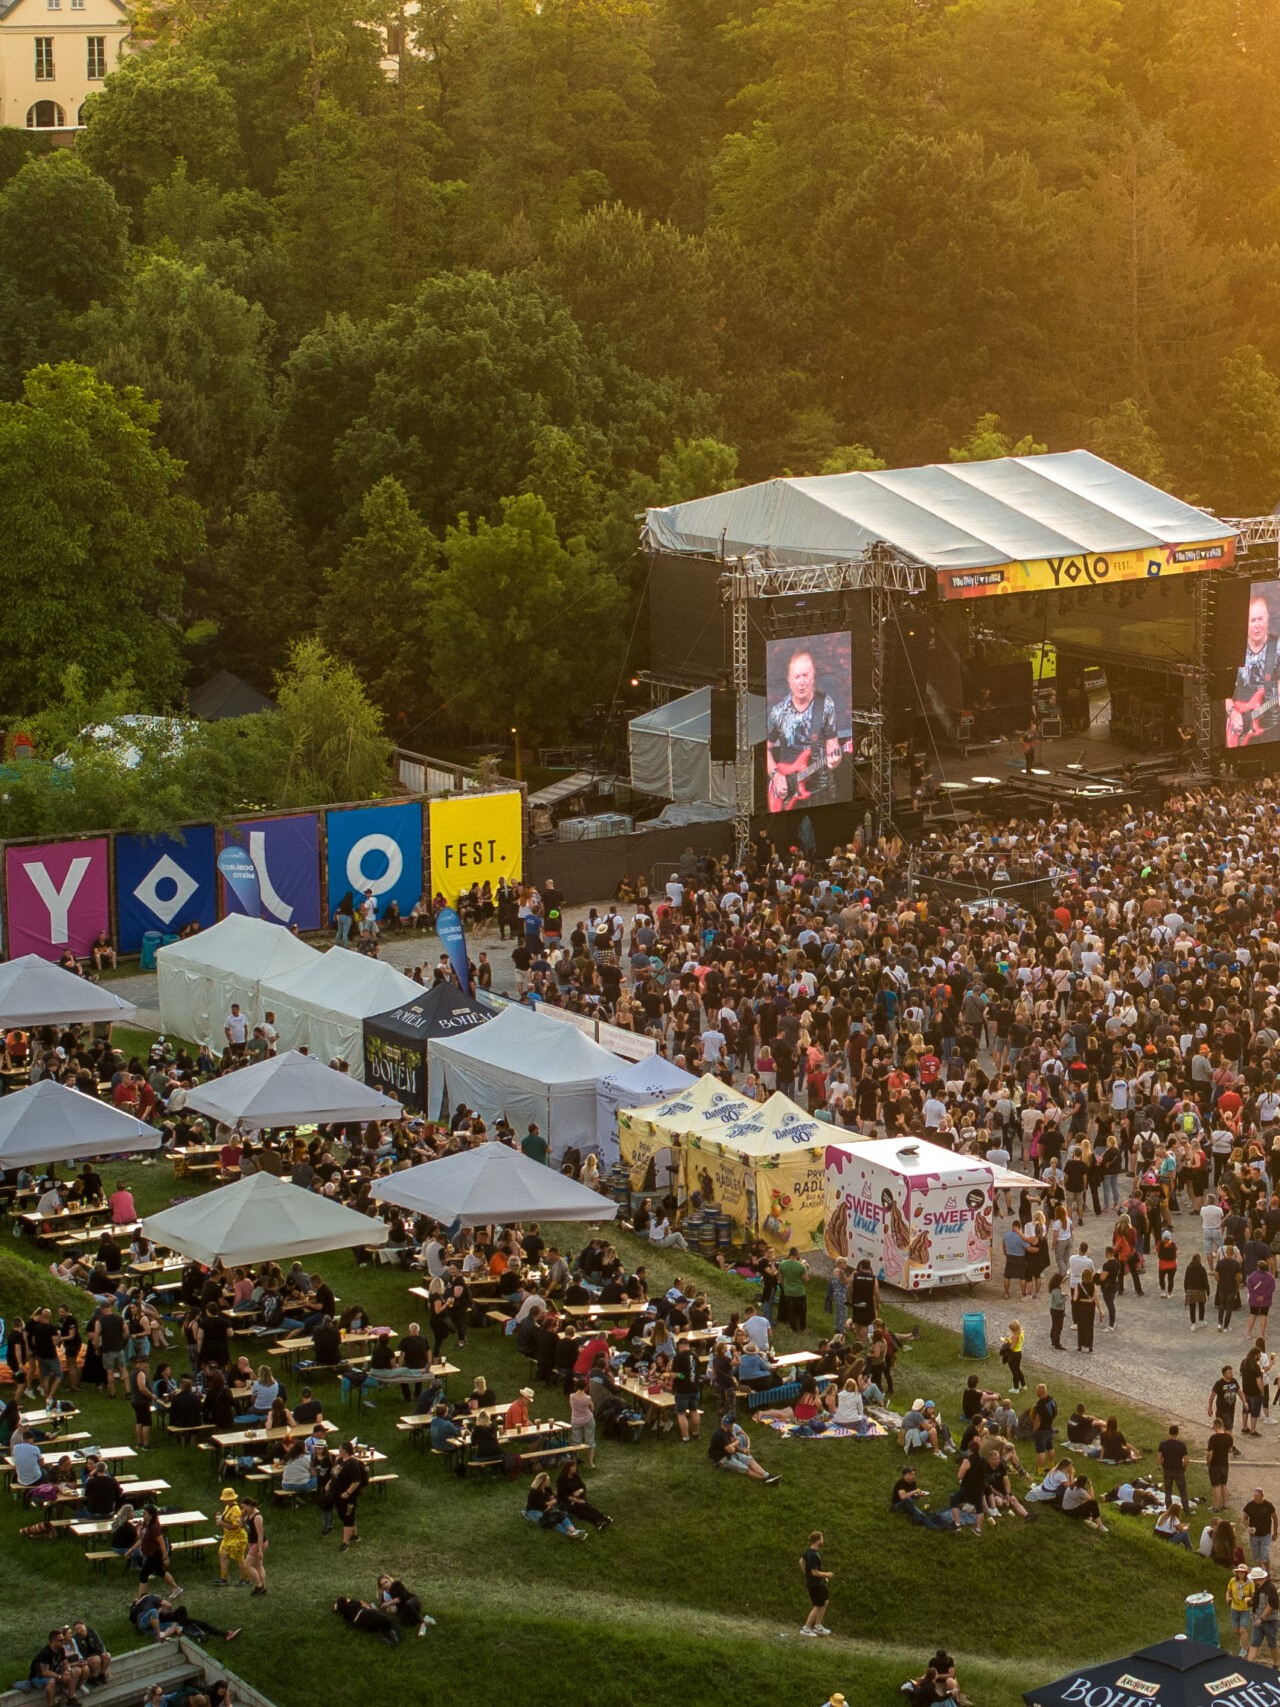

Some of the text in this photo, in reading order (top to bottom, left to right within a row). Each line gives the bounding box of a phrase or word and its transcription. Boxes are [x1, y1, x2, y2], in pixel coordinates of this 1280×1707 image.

[1046, 555, 1109, 586] YOLO
[446, 840, 506, 868] FEST.
[372, 1054, 416, 1094] BOHÉM
[794, 1179, 824, 1197] RADL
[845, 1193, 887, 1224] SWEET
[853, 1210, 878, 1235] truck
[923, 1208, 976, 1225] SWEET
[935, 1219, 965, 1235] truck
[1061, 1678, 1161, 1707] BOH
